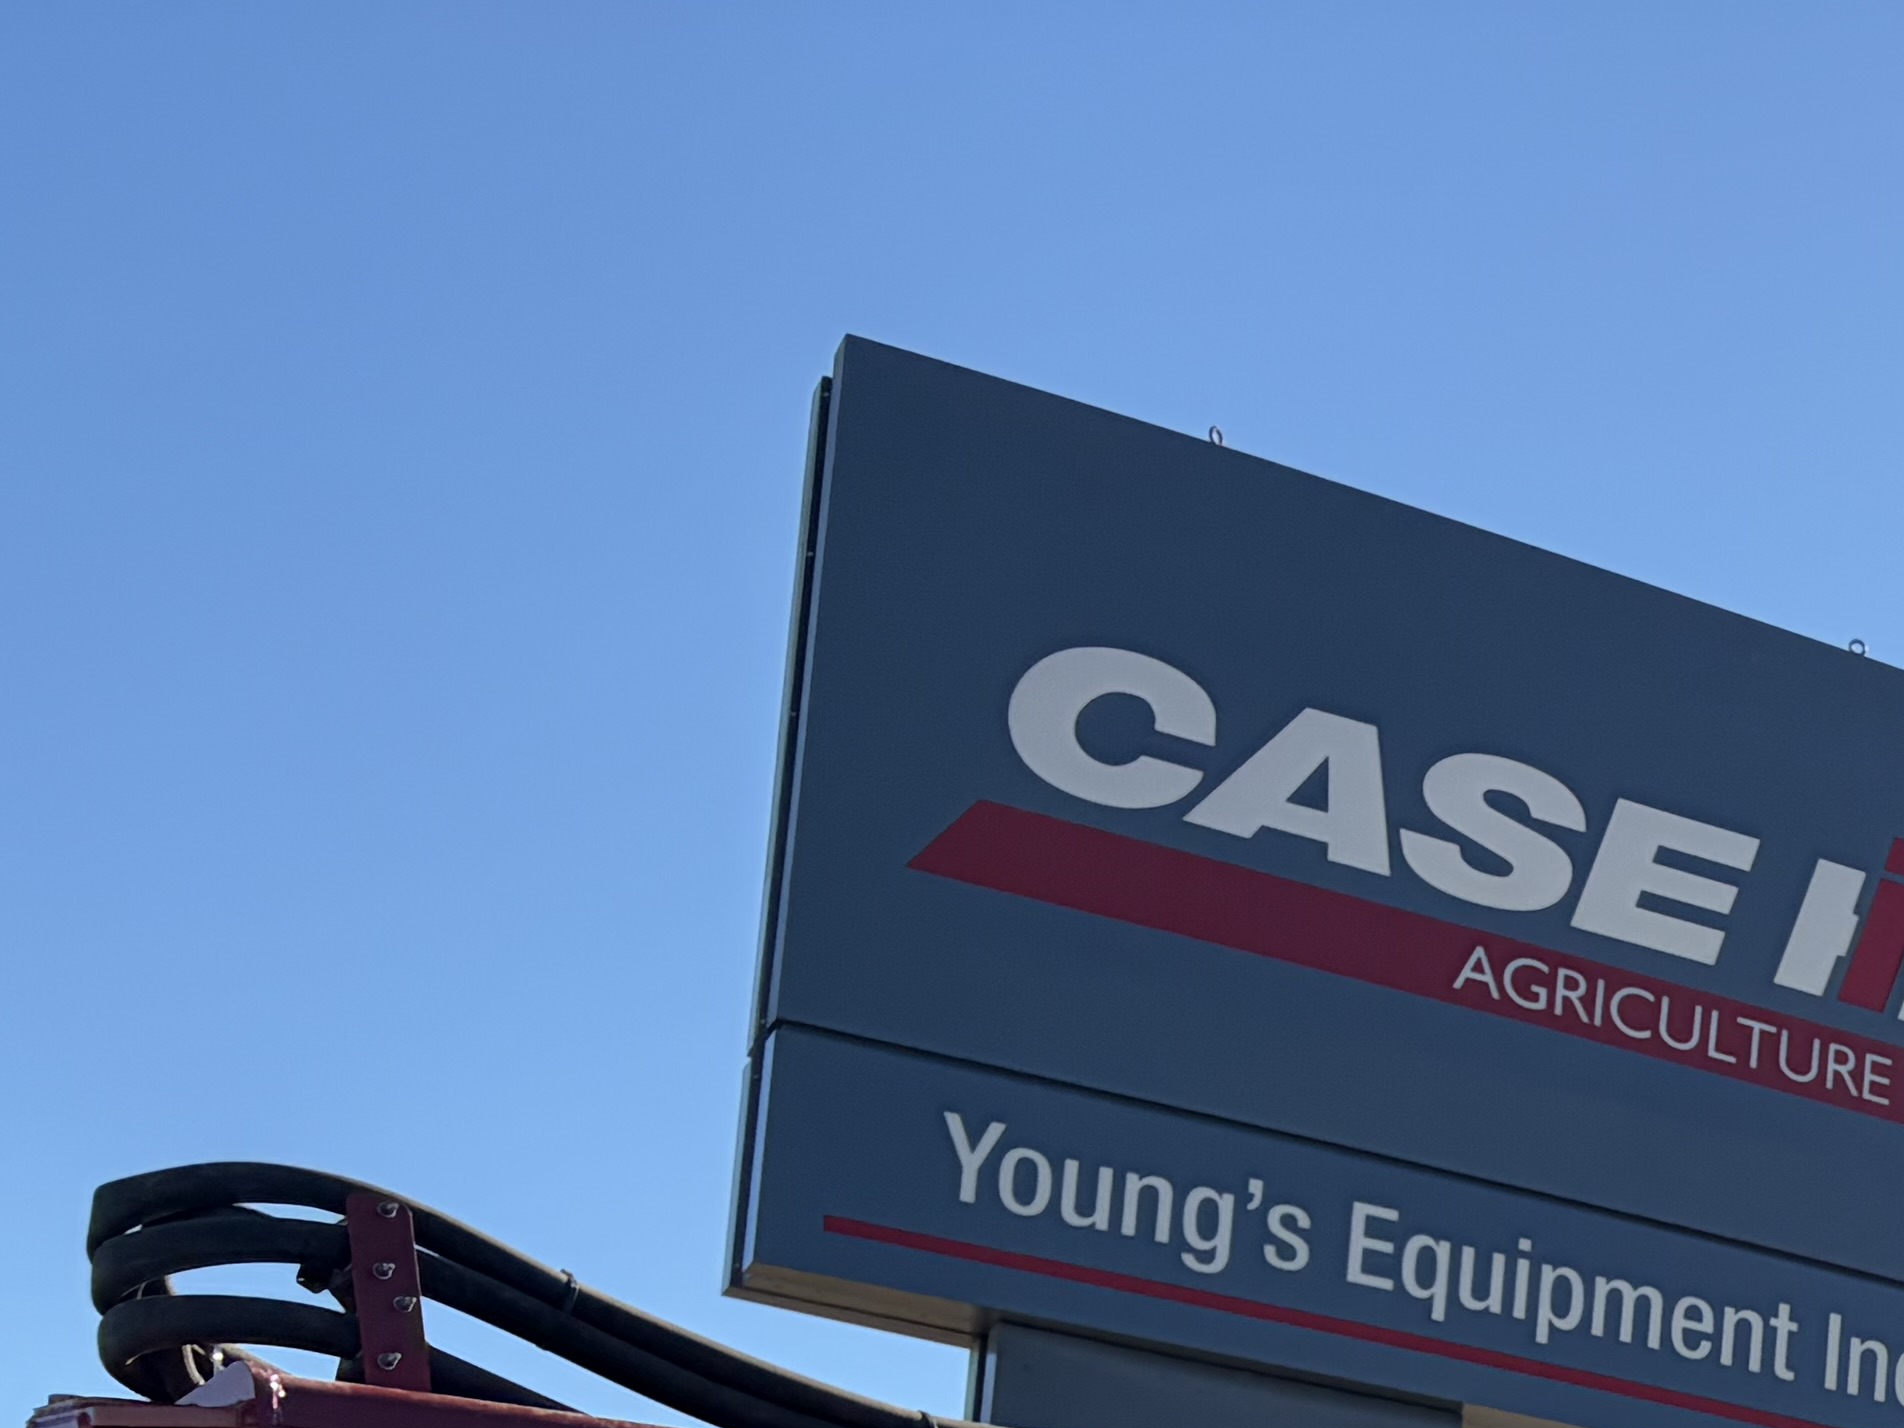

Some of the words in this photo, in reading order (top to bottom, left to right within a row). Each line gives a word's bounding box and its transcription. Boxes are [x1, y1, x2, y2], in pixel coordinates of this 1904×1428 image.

[1006, 646, 1760, 966] CASE
[1452, 945, 1894, 1106] AGRICULTURE
[942, 1110, 1312, 1275] Young's
[1346, 1201, 1798, 1384] Equipment
